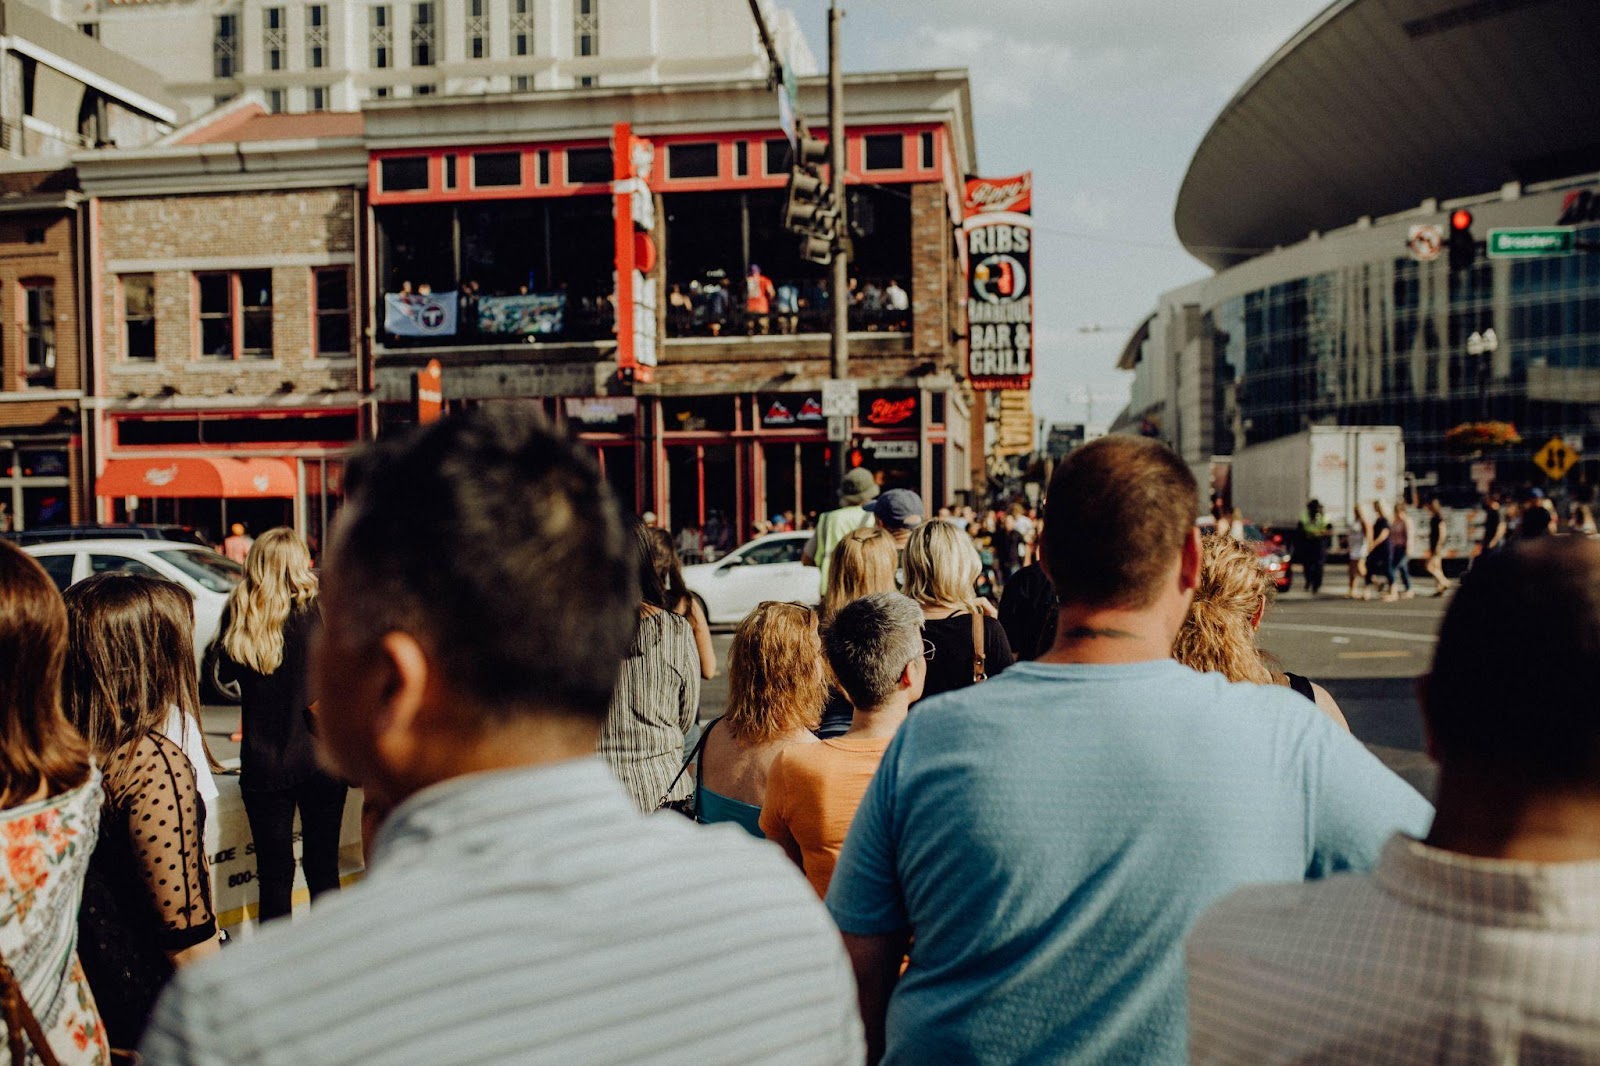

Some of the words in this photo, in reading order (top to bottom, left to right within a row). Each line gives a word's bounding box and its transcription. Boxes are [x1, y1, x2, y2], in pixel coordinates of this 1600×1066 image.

[970, 225, 1030, 254] RIBS
[970, 324, 1012, 350] BAR
[1014, 323, 1030, 350] &
[970, 350, 1031, 375] GRILL
